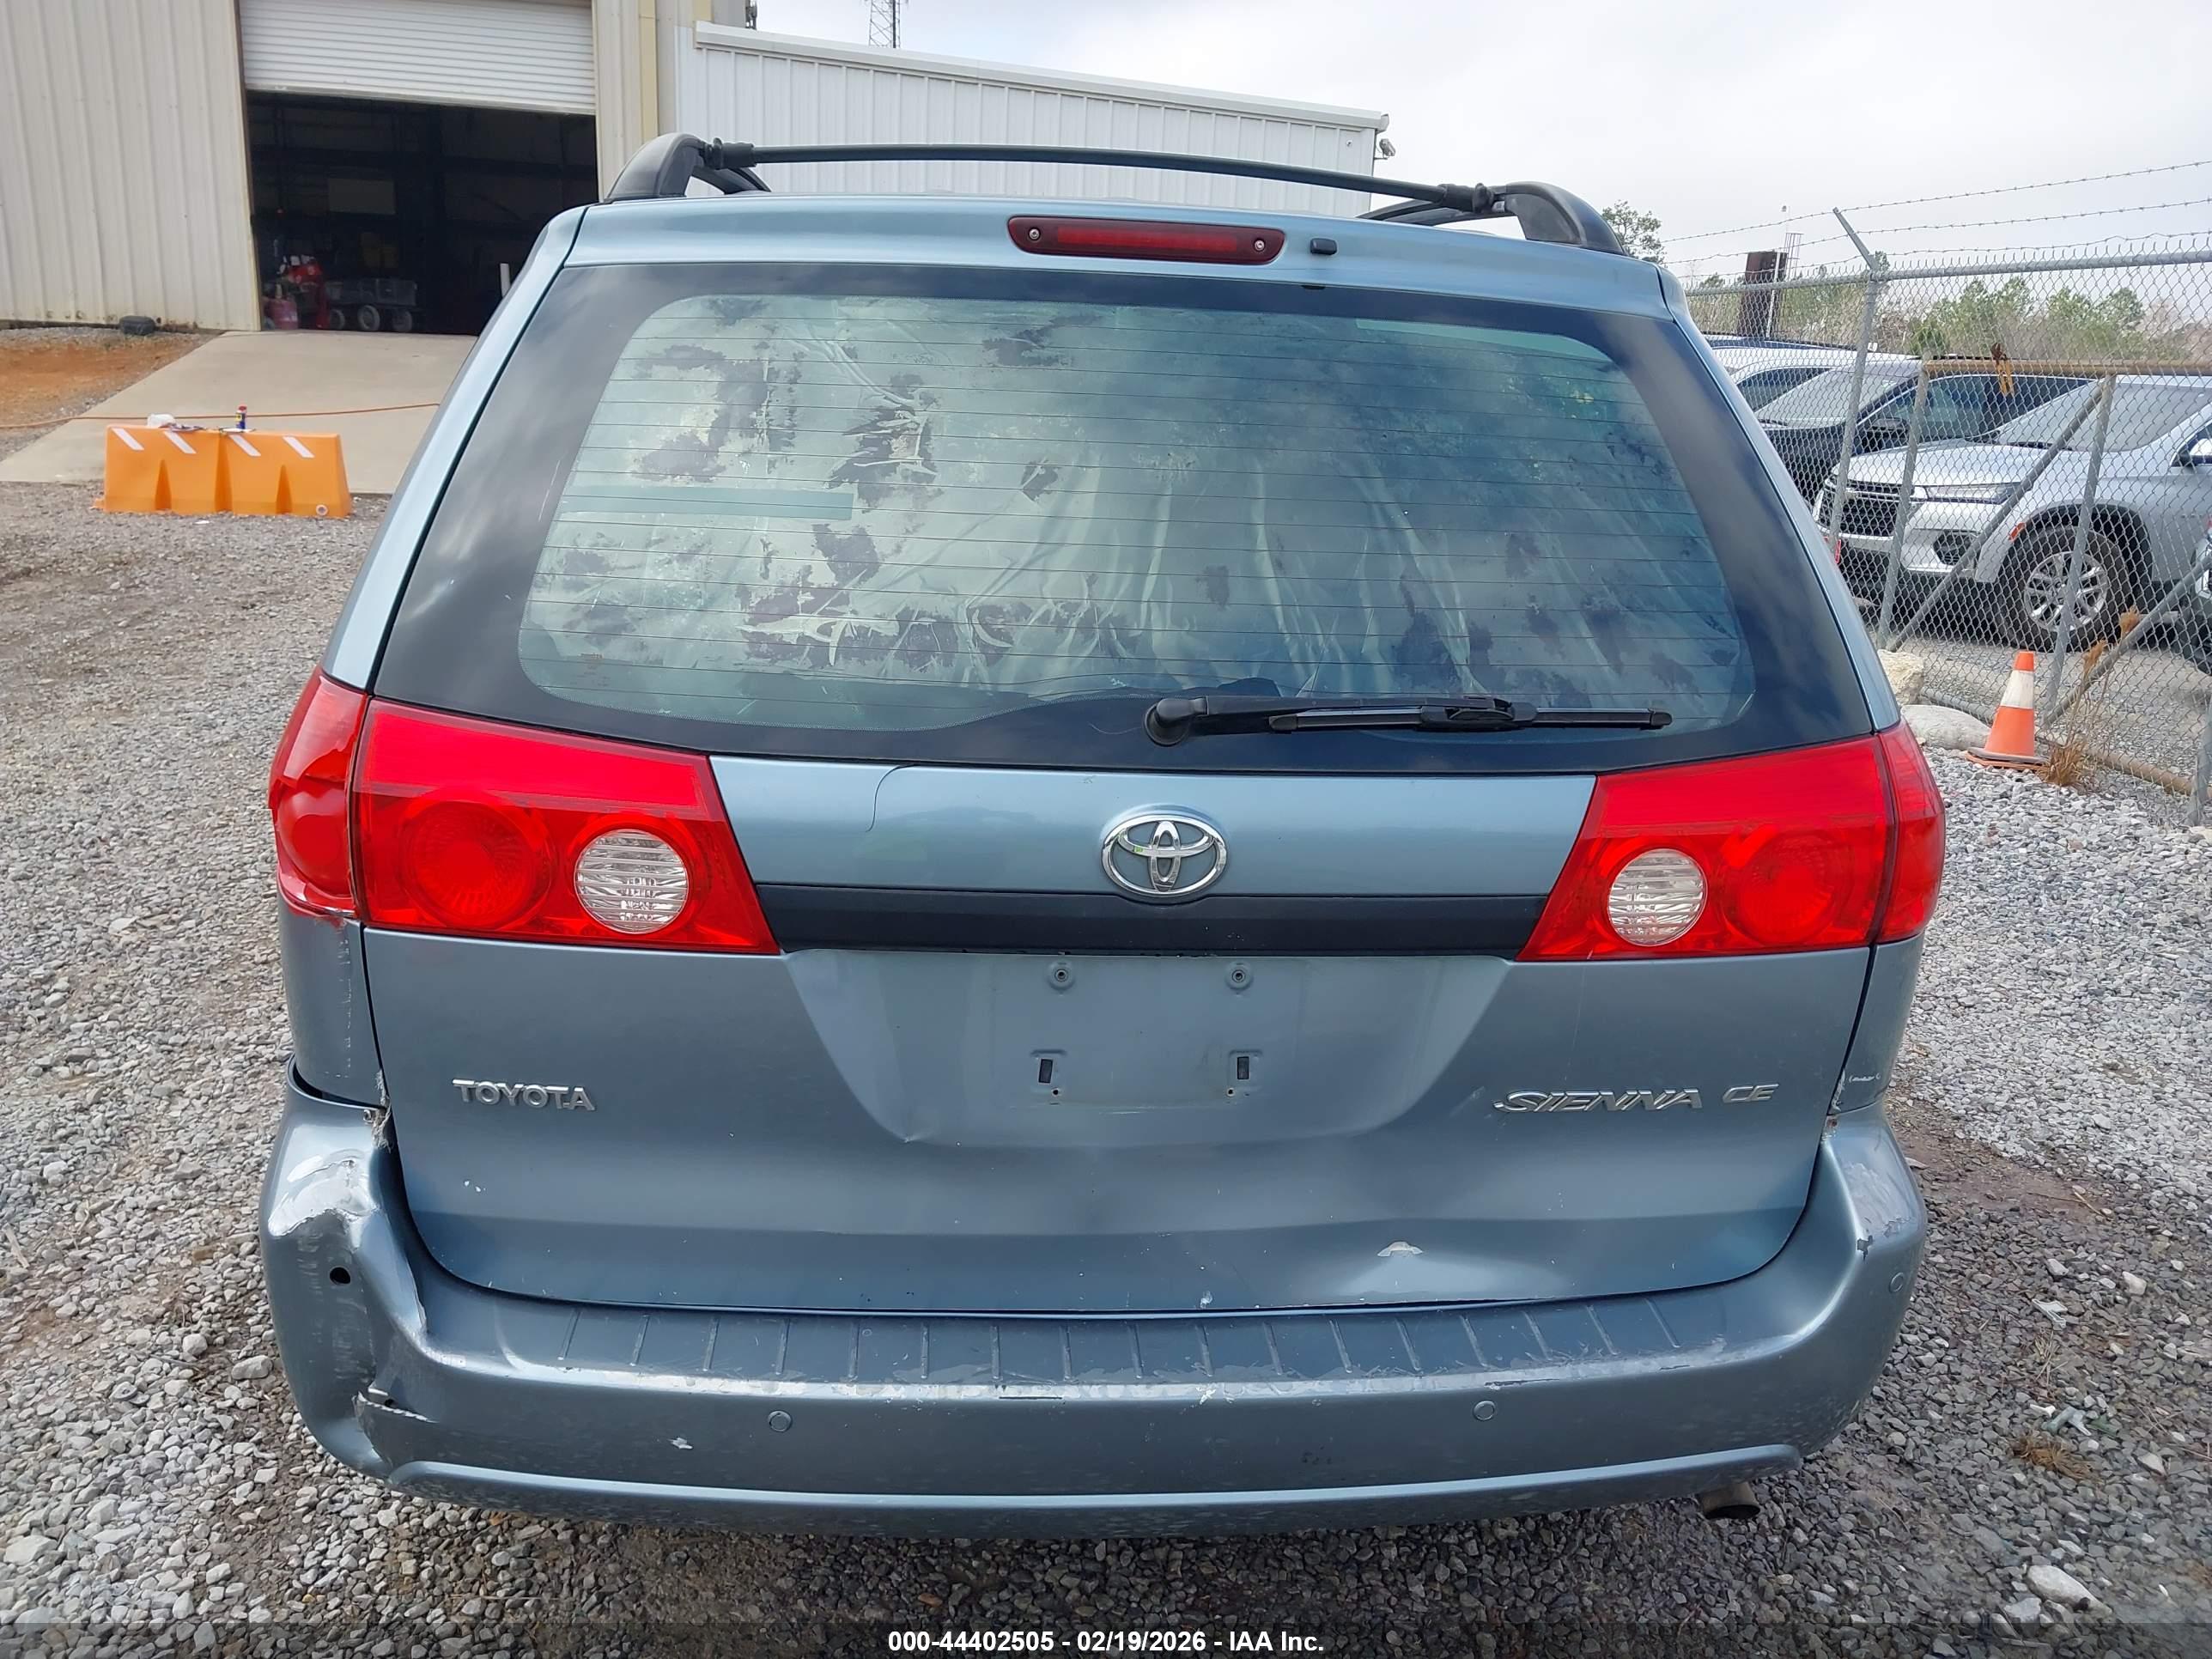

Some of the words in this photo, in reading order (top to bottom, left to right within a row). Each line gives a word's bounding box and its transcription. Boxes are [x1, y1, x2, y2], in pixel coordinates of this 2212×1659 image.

[452, 1078, 596, 1112] TOYOTA
[1492, 1088, 1704, 1113] SIENNA
[1722, 1083, 1780, 1104] CE
